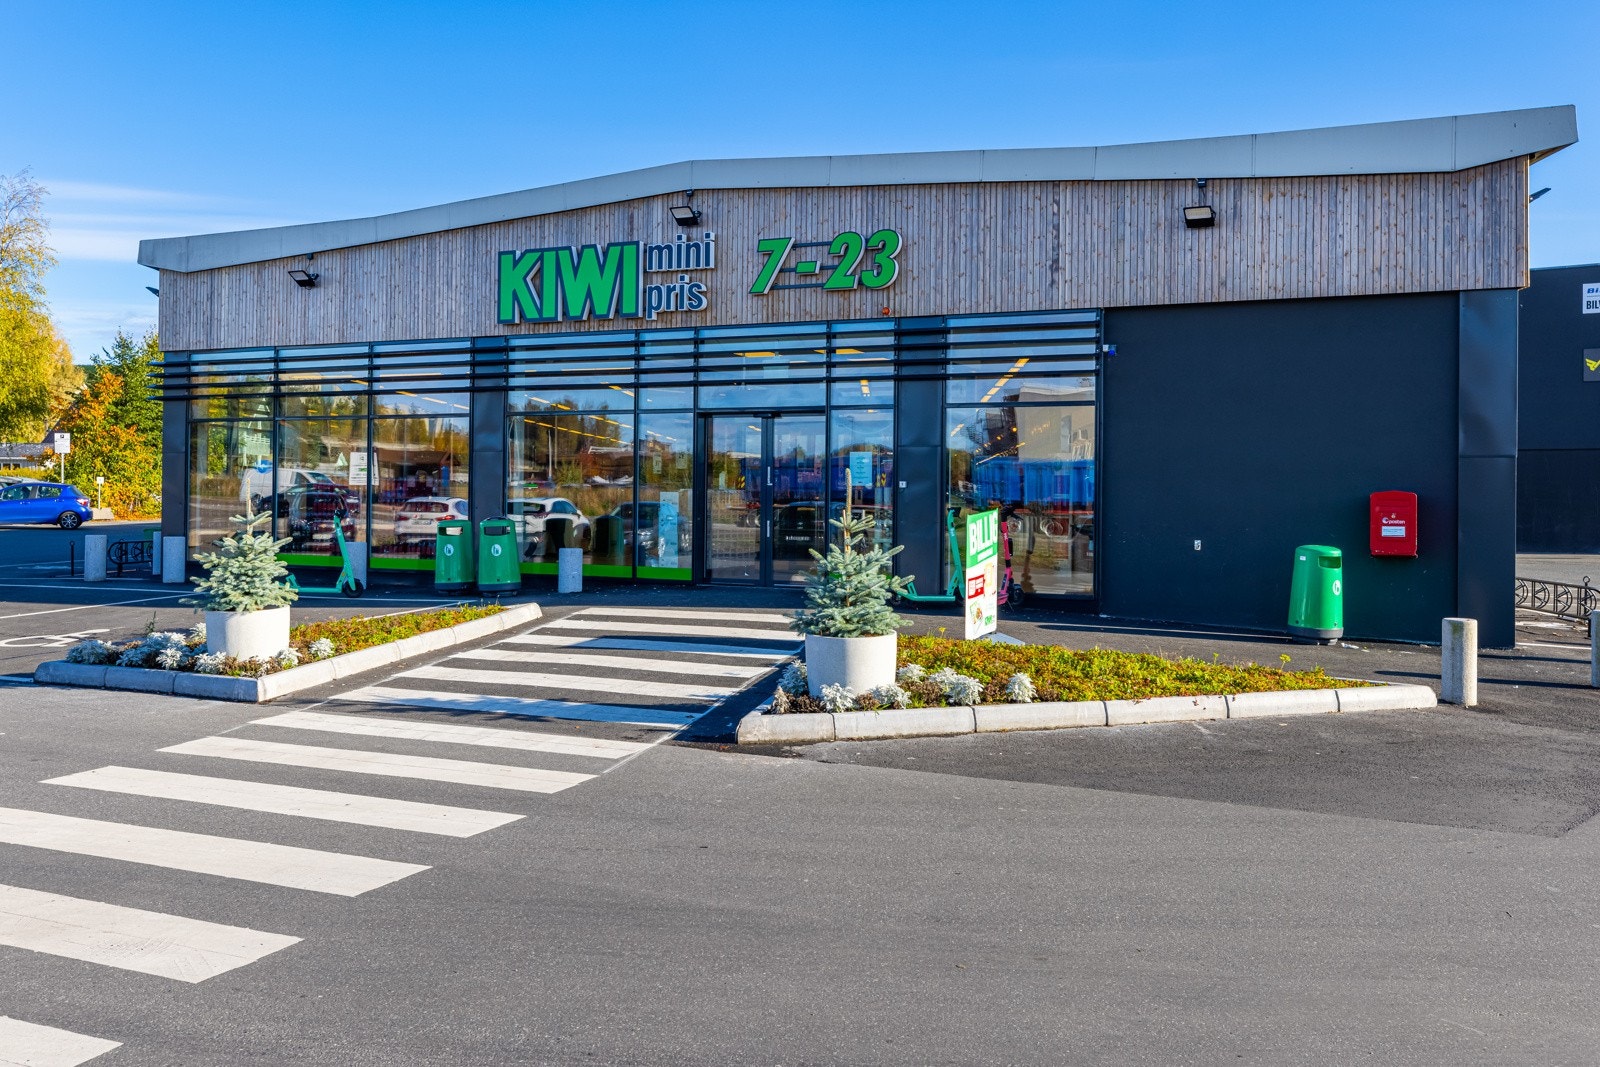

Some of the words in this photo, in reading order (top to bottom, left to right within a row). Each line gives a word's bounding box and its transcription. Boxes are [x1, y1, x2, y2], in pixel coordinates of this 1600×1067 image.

[646, 232, 715, 271] mini
[748, 229, 902, 294] 7-23
[498, 240, 643, 324] KIWI
[646, 274, 707, 320] pris
